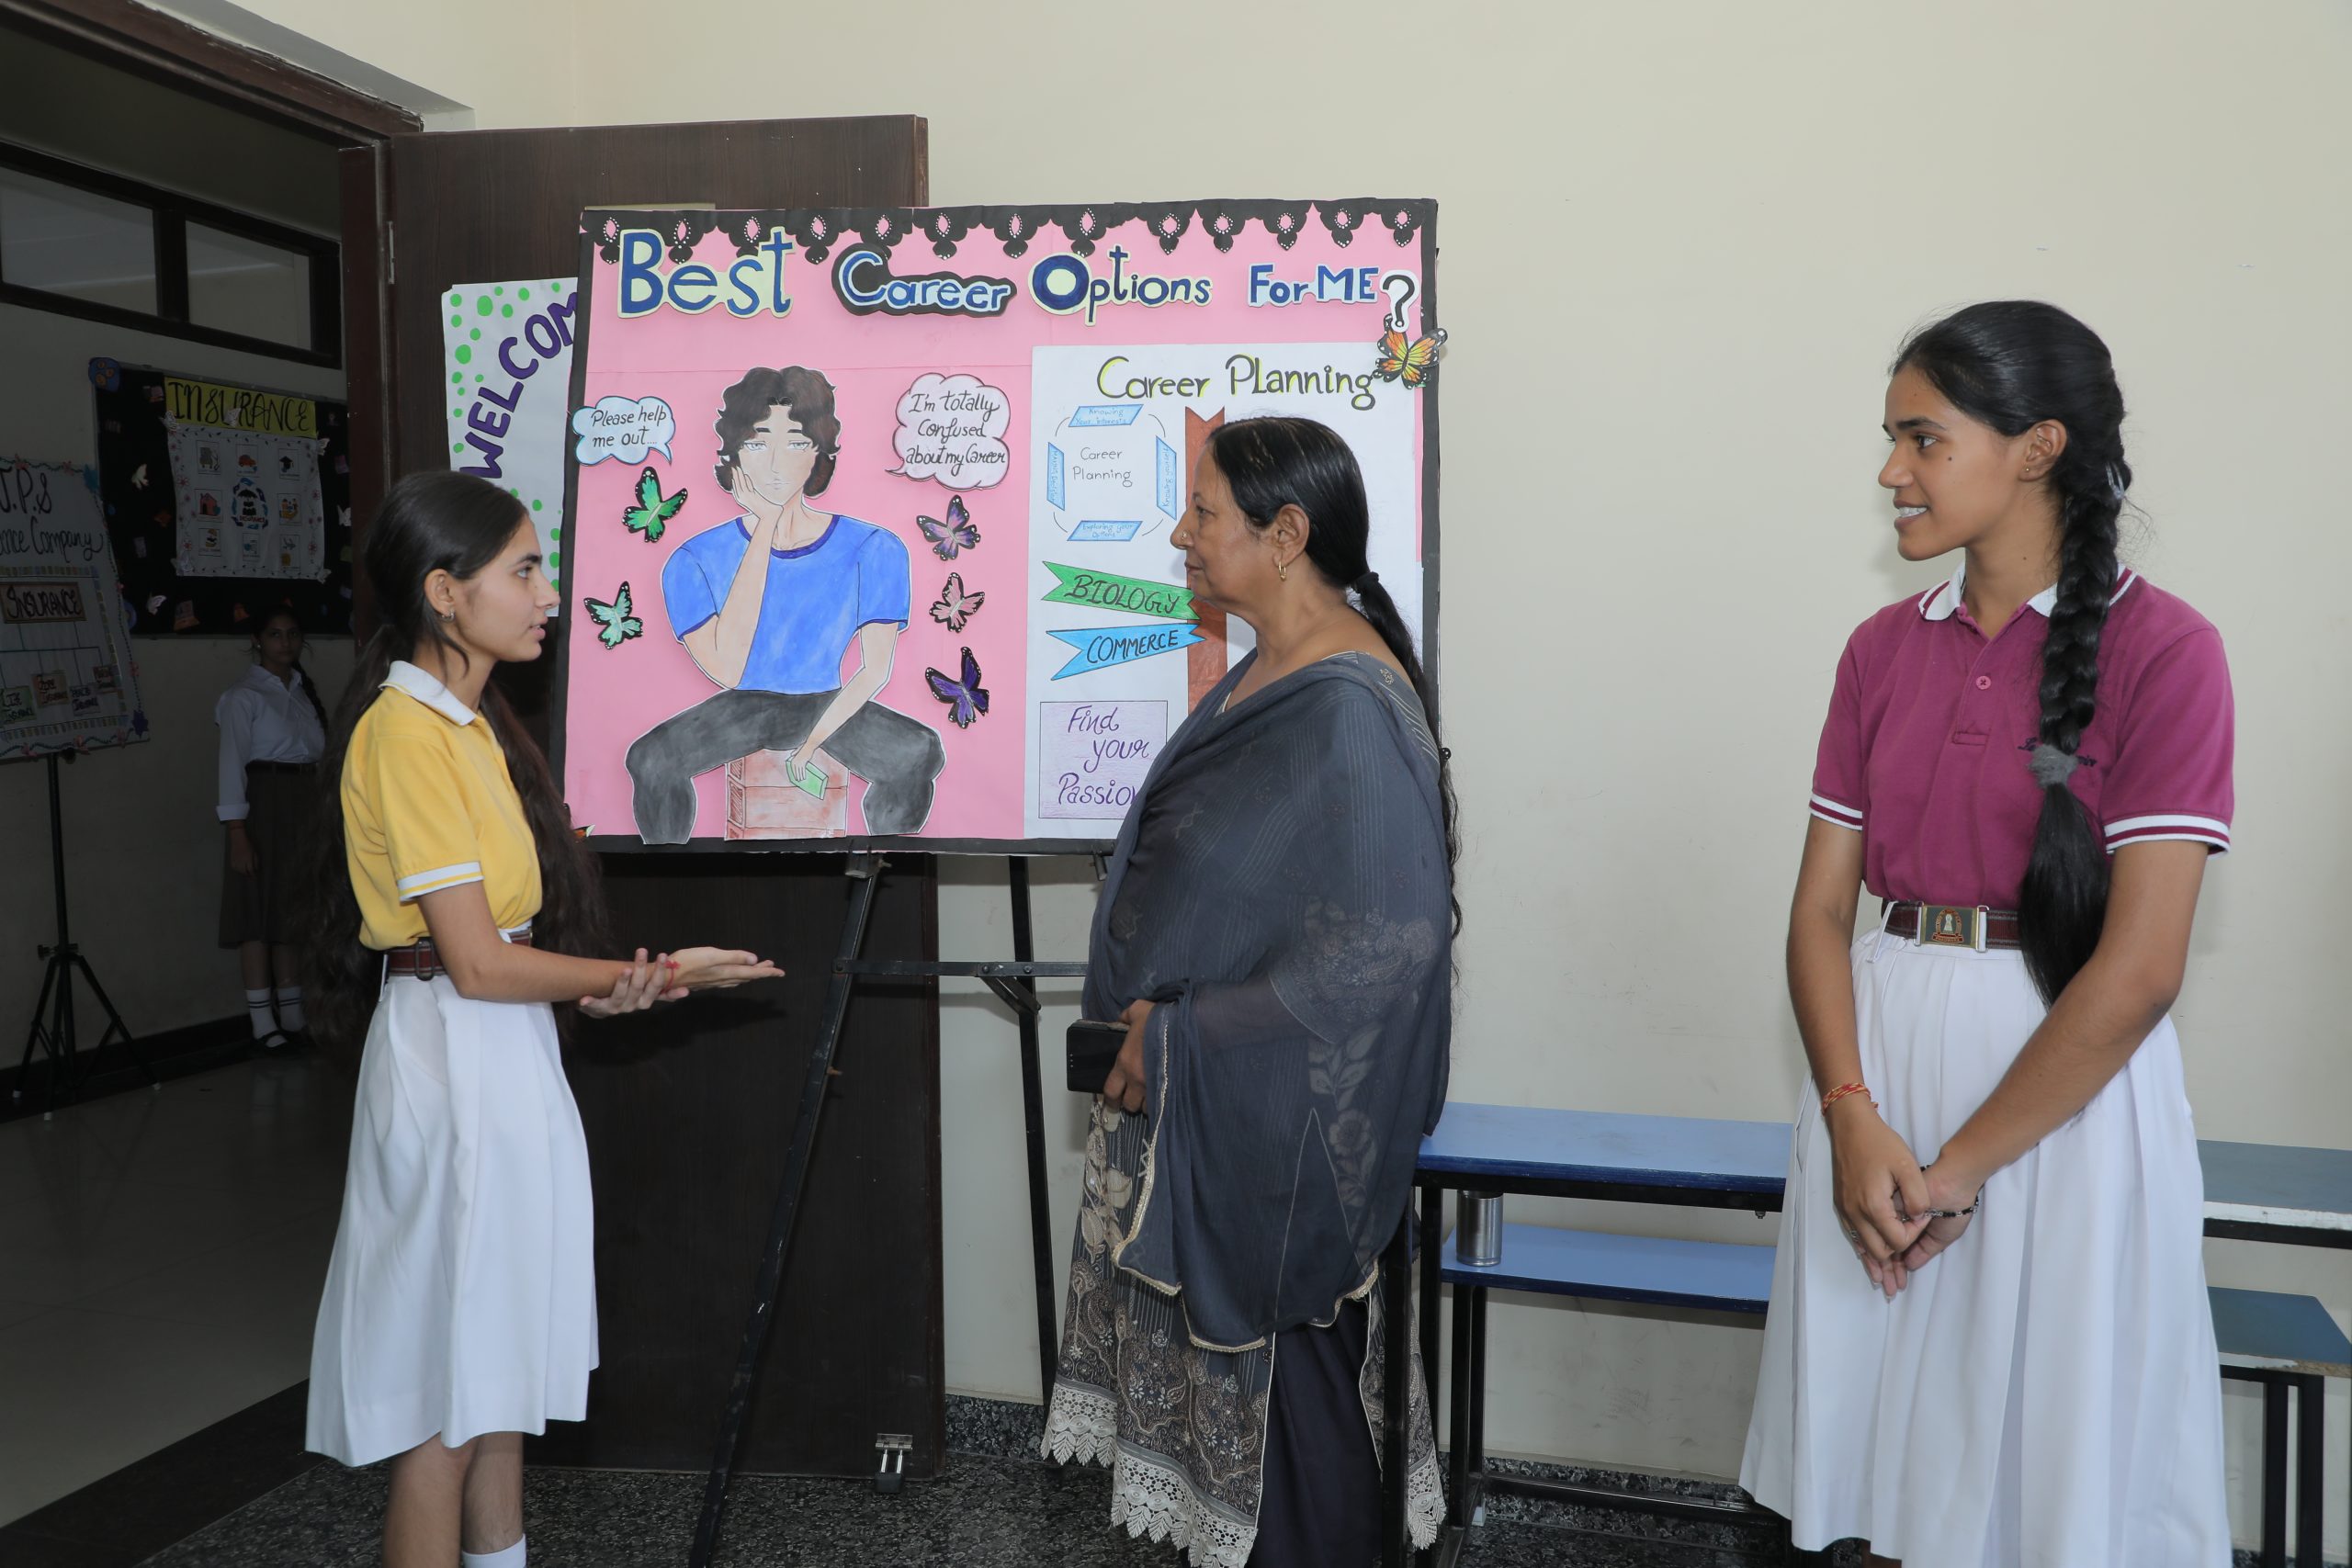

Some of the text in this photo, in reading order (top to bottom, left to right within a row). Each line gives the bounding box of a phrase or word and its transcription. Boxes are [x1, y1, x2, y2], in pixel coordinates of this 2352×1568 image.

[621, 224, 796, 316] Best
[837, 249, 1012, 311] Career
[1030, 244, 1213, 324] Options
[1250, 264, 1309, 304] For
[1095, 355, 1211, 399] Career
[591, 404, 667, 427] Please help
[909, 389, 1001, 423] I'm totally
[593, 434, 615, 448] me
[1080, 446, 1124, 461] Career
[906, 445, 946, 465] about
[945, 452, 966, 477] my
[1072, 466, 1134, 488] Planning
[30, 514, 104, 564] Company
[1065, 574, 1182, 615] BIOLOGY
[1086, 629, 1180, 665] COMMERCE
[1068, 705, 1120, 736] Find
[1083, 739, 1150, 773] your
